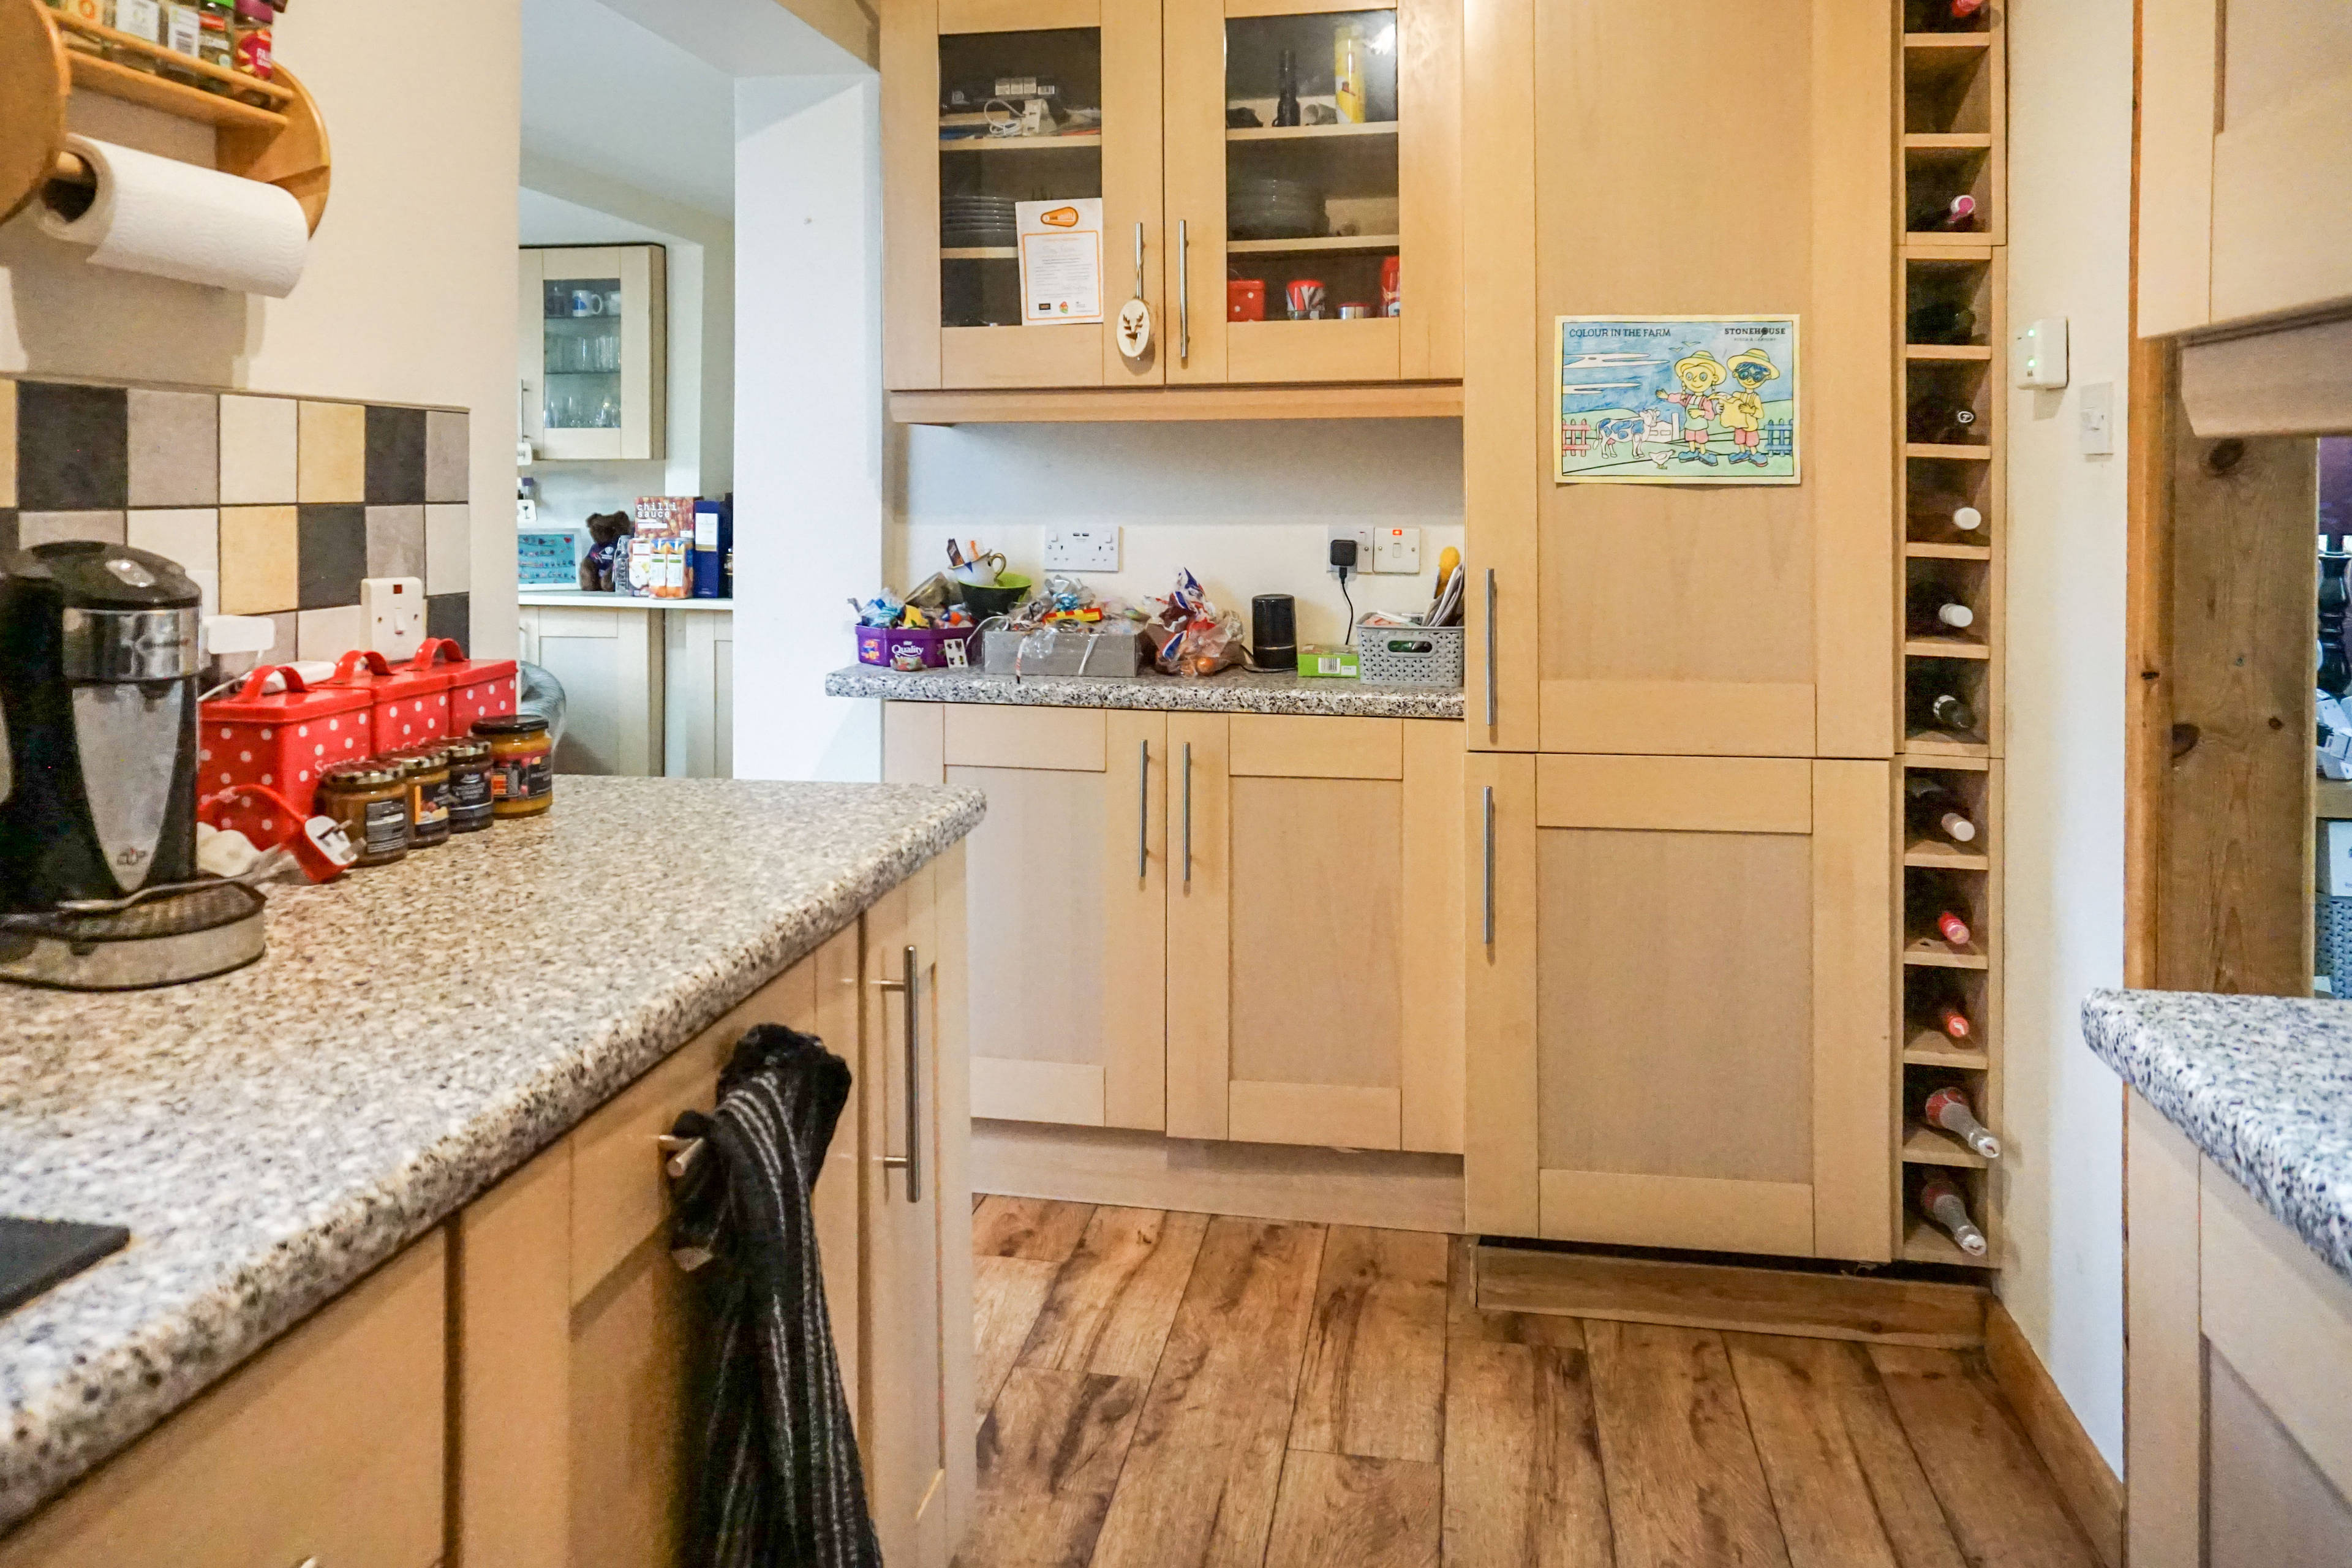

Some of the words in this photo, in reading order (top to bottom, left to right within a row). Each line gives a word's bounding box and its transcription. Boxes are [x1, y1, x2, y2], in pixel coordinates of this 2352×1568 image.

[1569, 329, 1608, 337] COLOUR
[1643, 328, 1671, 337] FARM
[1724, 327, 1786, 336] STONEHOUSE
[637, 502, 677, 511] chilli
[891, 644, 924, 657] Quality
